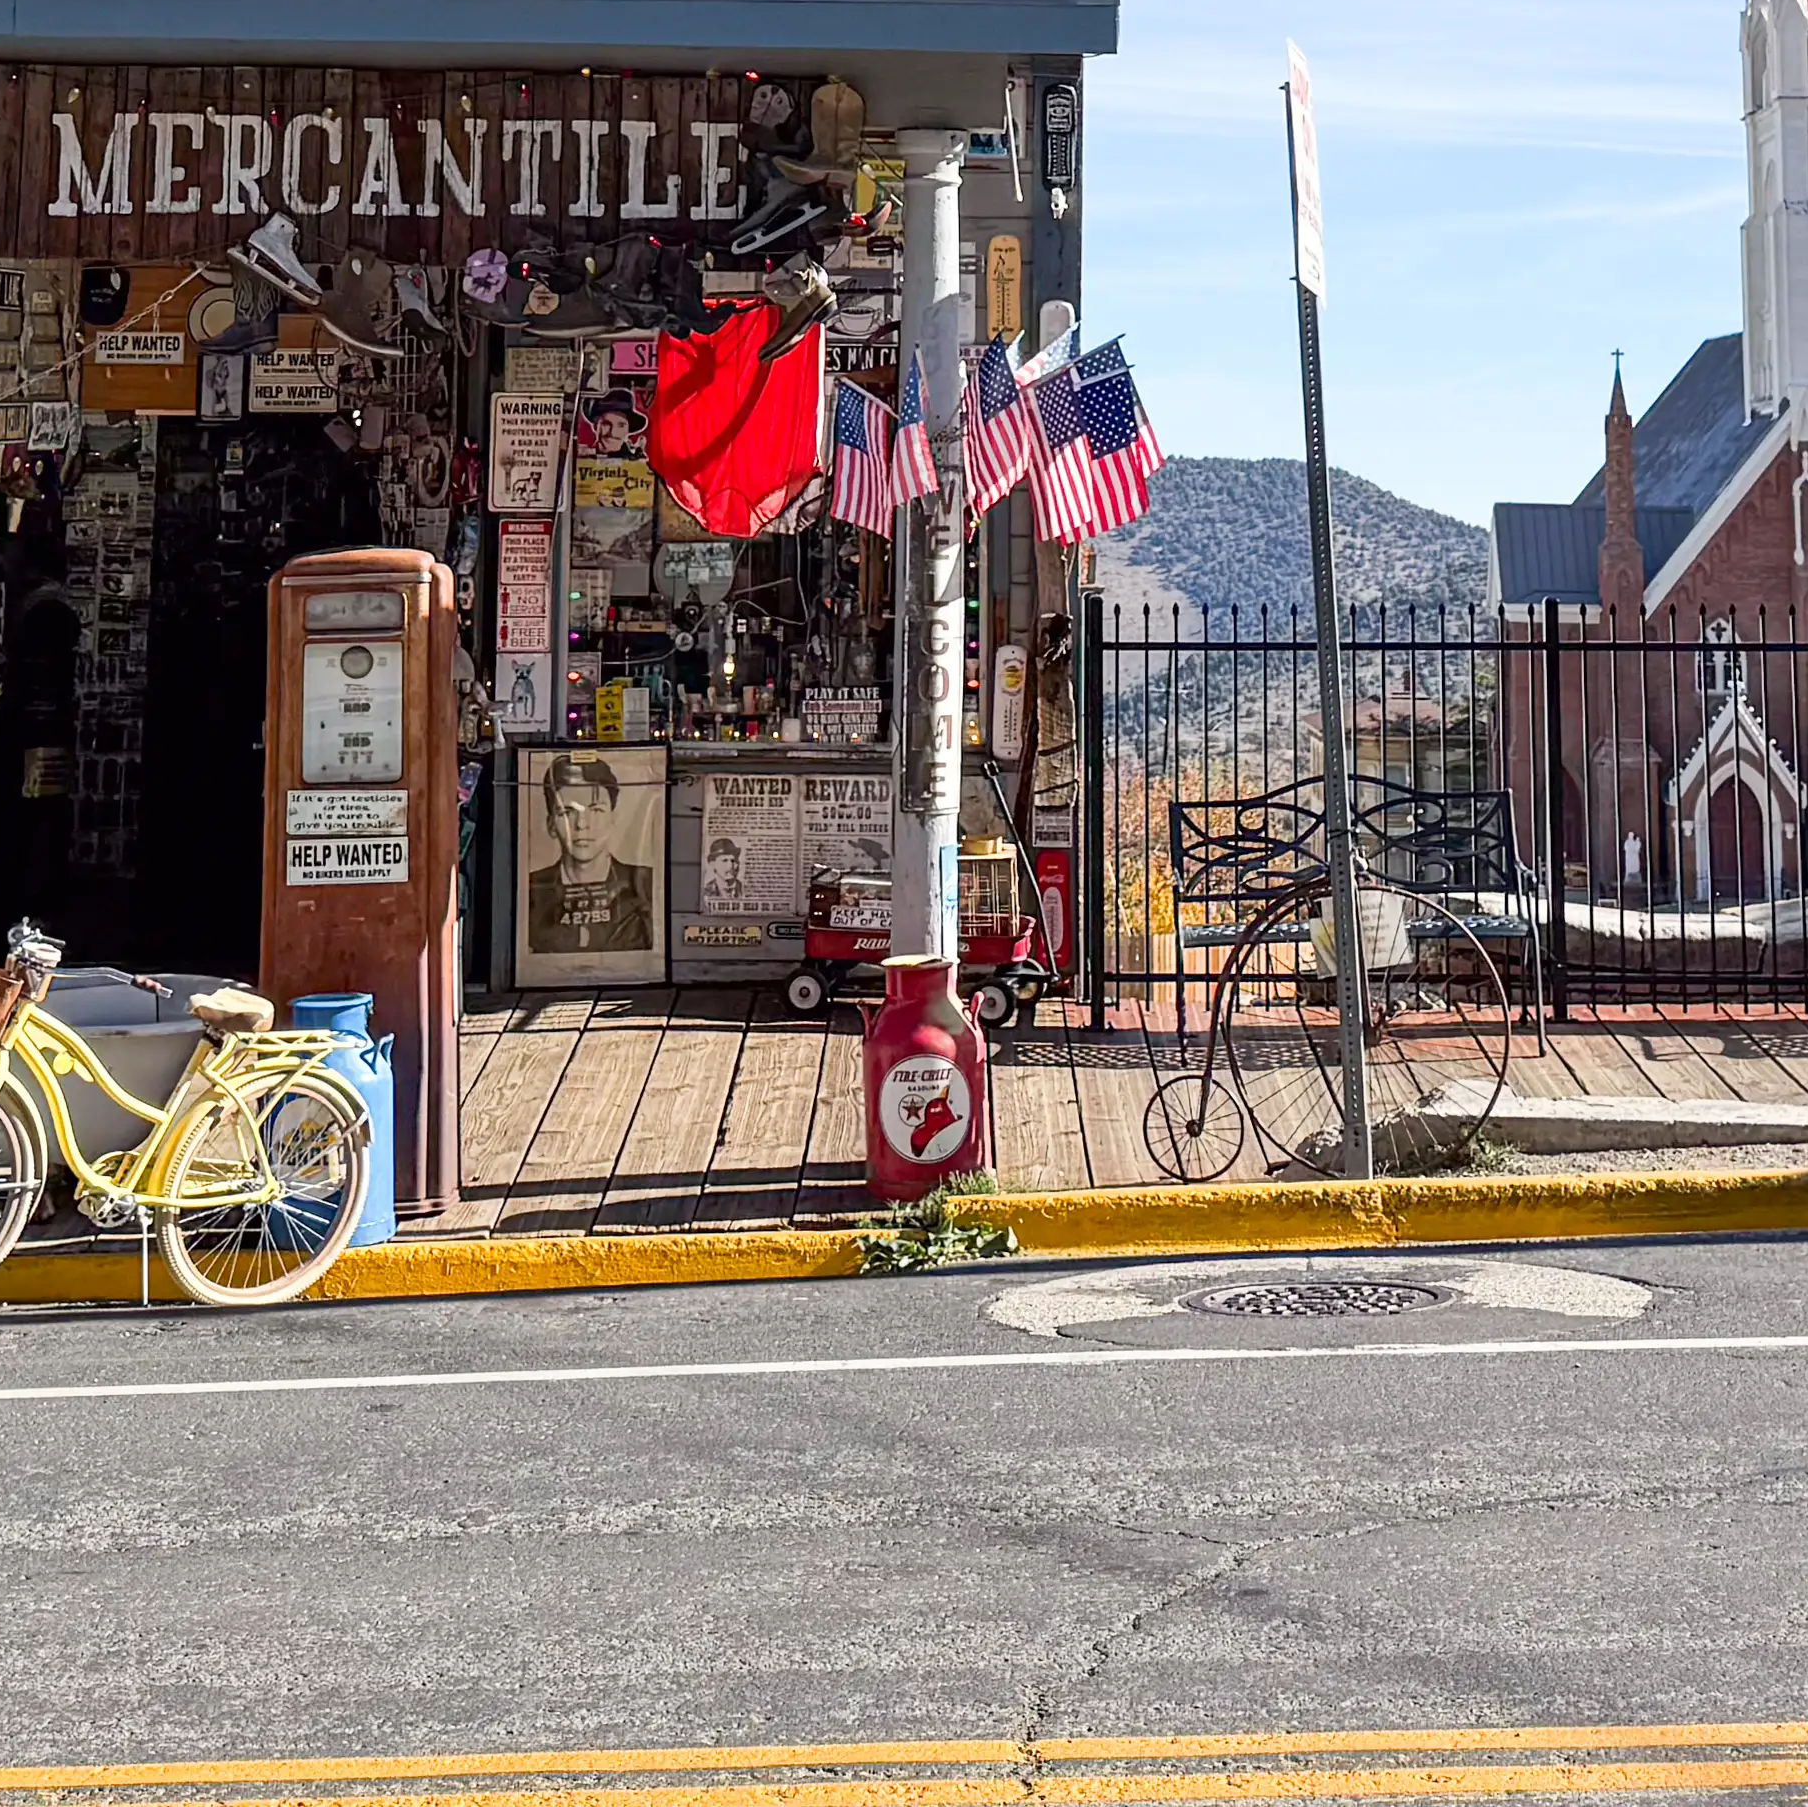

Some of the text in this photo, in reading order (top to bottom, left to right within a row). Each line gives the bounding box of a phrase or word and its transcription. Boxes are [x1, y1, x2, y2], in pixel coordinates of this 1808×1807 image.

[47, 112, 751, 220] MERCANTILE
[99, 336, 180, 351] HELP WANTED
[257, 354, 335, 366] HELP WANTED
[255, 386, 333, 399] HELP WANTED
[501, 403, 561, 415] WARNING
[501, 418, 559, 426] THIS PROPERTY
[502, 428, 557, 436] PROTECTED BY
[579, 468, 629, 480] Virginia
[623, 476, 653, 490] City
[523, 538, 545, 546] PLACE
[517, 596, 539, 604] NO
[511, 628, 545, 637] FREE
[511, 638, 545, 647] BEER
[805, 686, 880, 700] PLAY IT SAFE
[713, 778, 791, 795] WANTED
[805, 779, 890, 802] REWARD
[327, 796, 347, 804] got
[294, 822, 348, 830] give you
[292, 842, 403, 868] HELP WANTED
[303, 868, 391, 879] NO BIKERS NEED APPLY
[559, 910, 611, 925] 42799
[836, 908, 865, 918] KEEP
[833, 917, 873, 926] OUT OF
[698, 926, 747, 935] PLEASE
[687, 936, 761, 945] NO FARTING
[893, 1068, 953, 1082] FIRE-CHIEF
[907, 1084, 941, 1092] GASOLINE
